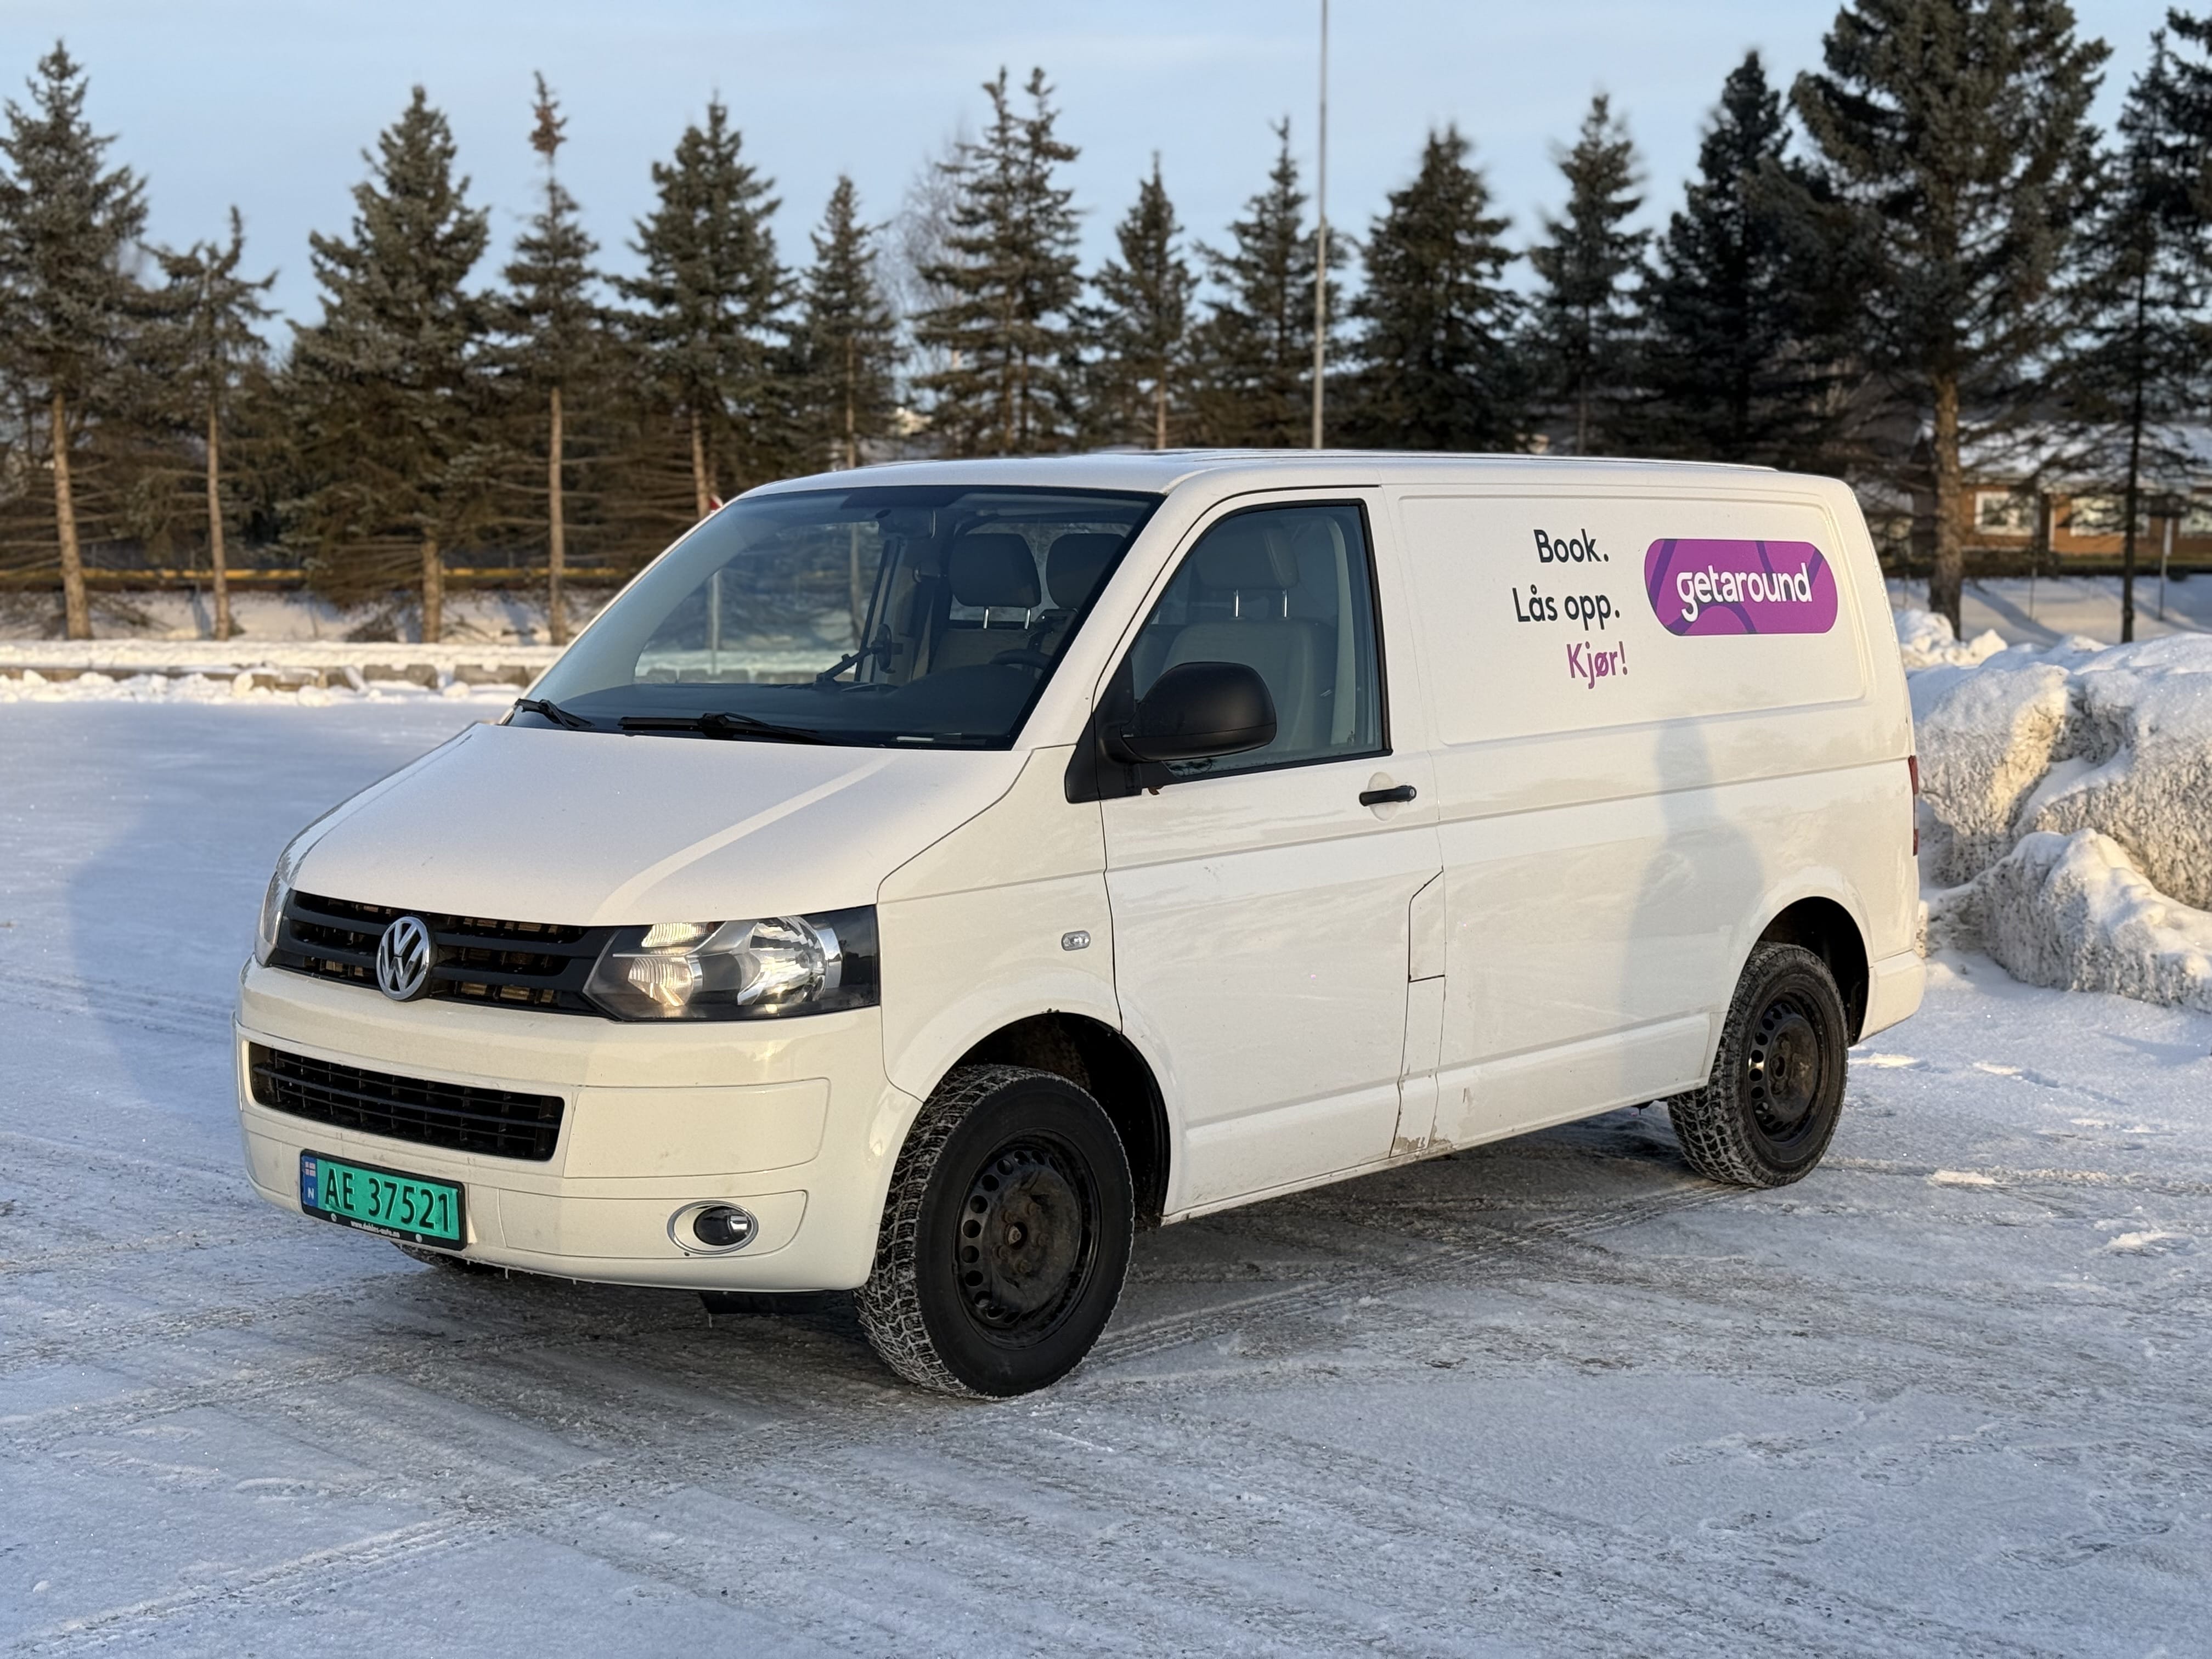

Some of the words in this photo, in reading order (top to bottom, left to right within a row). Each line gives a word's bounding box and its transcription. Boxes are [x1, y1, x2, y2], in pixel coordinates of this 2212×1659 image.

[1534, 529, 1609, 562] Book.
[1513, 584, 1558, 622] Lås
[1564, 592, 1620, 631] opp.
[1677, 562, 1812, 622] getaround
[1566, 641, 1628, 689] Kjør!
[307, 1187, 314, 1200] N
[325, 1168, 356, 1211] AE
[368, 1177, 451, 1232] 37521
